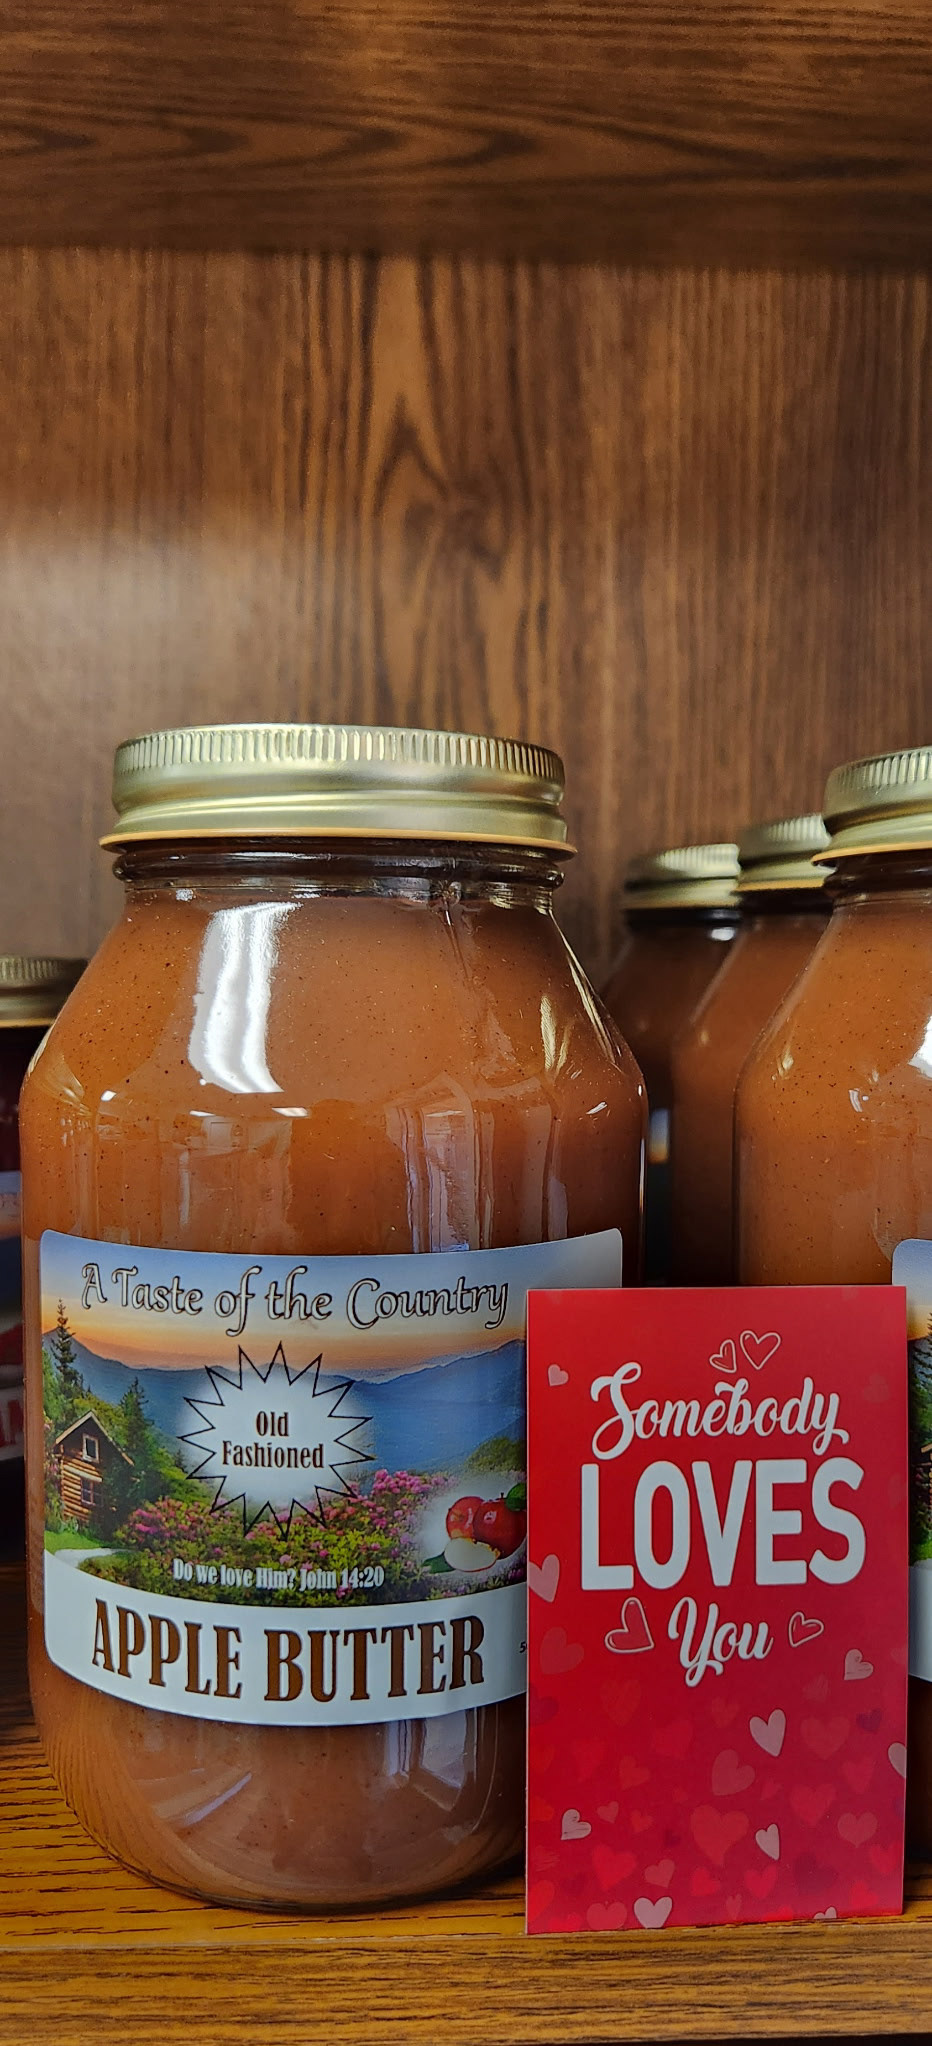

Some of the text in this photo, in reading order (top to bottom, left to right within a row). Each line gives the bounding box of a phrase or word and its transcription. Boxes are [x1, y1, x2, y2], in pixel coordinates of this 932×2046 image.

[81, 1263, 508, 1338] A Taste of the Country
[255, 1411, 289, 1437] Old
[590, 1362, 849, 1460] Somebody
[222, 1442, 324, 1469] Fashioned
[581, 1457, 866, 1590] LOVES
[172, 1558, 385, 1591] Do we love Him? John 14:20
[91, 1598, 485, 1702] APPLE BUTTER
[667, 1597, 774, 1687] You
